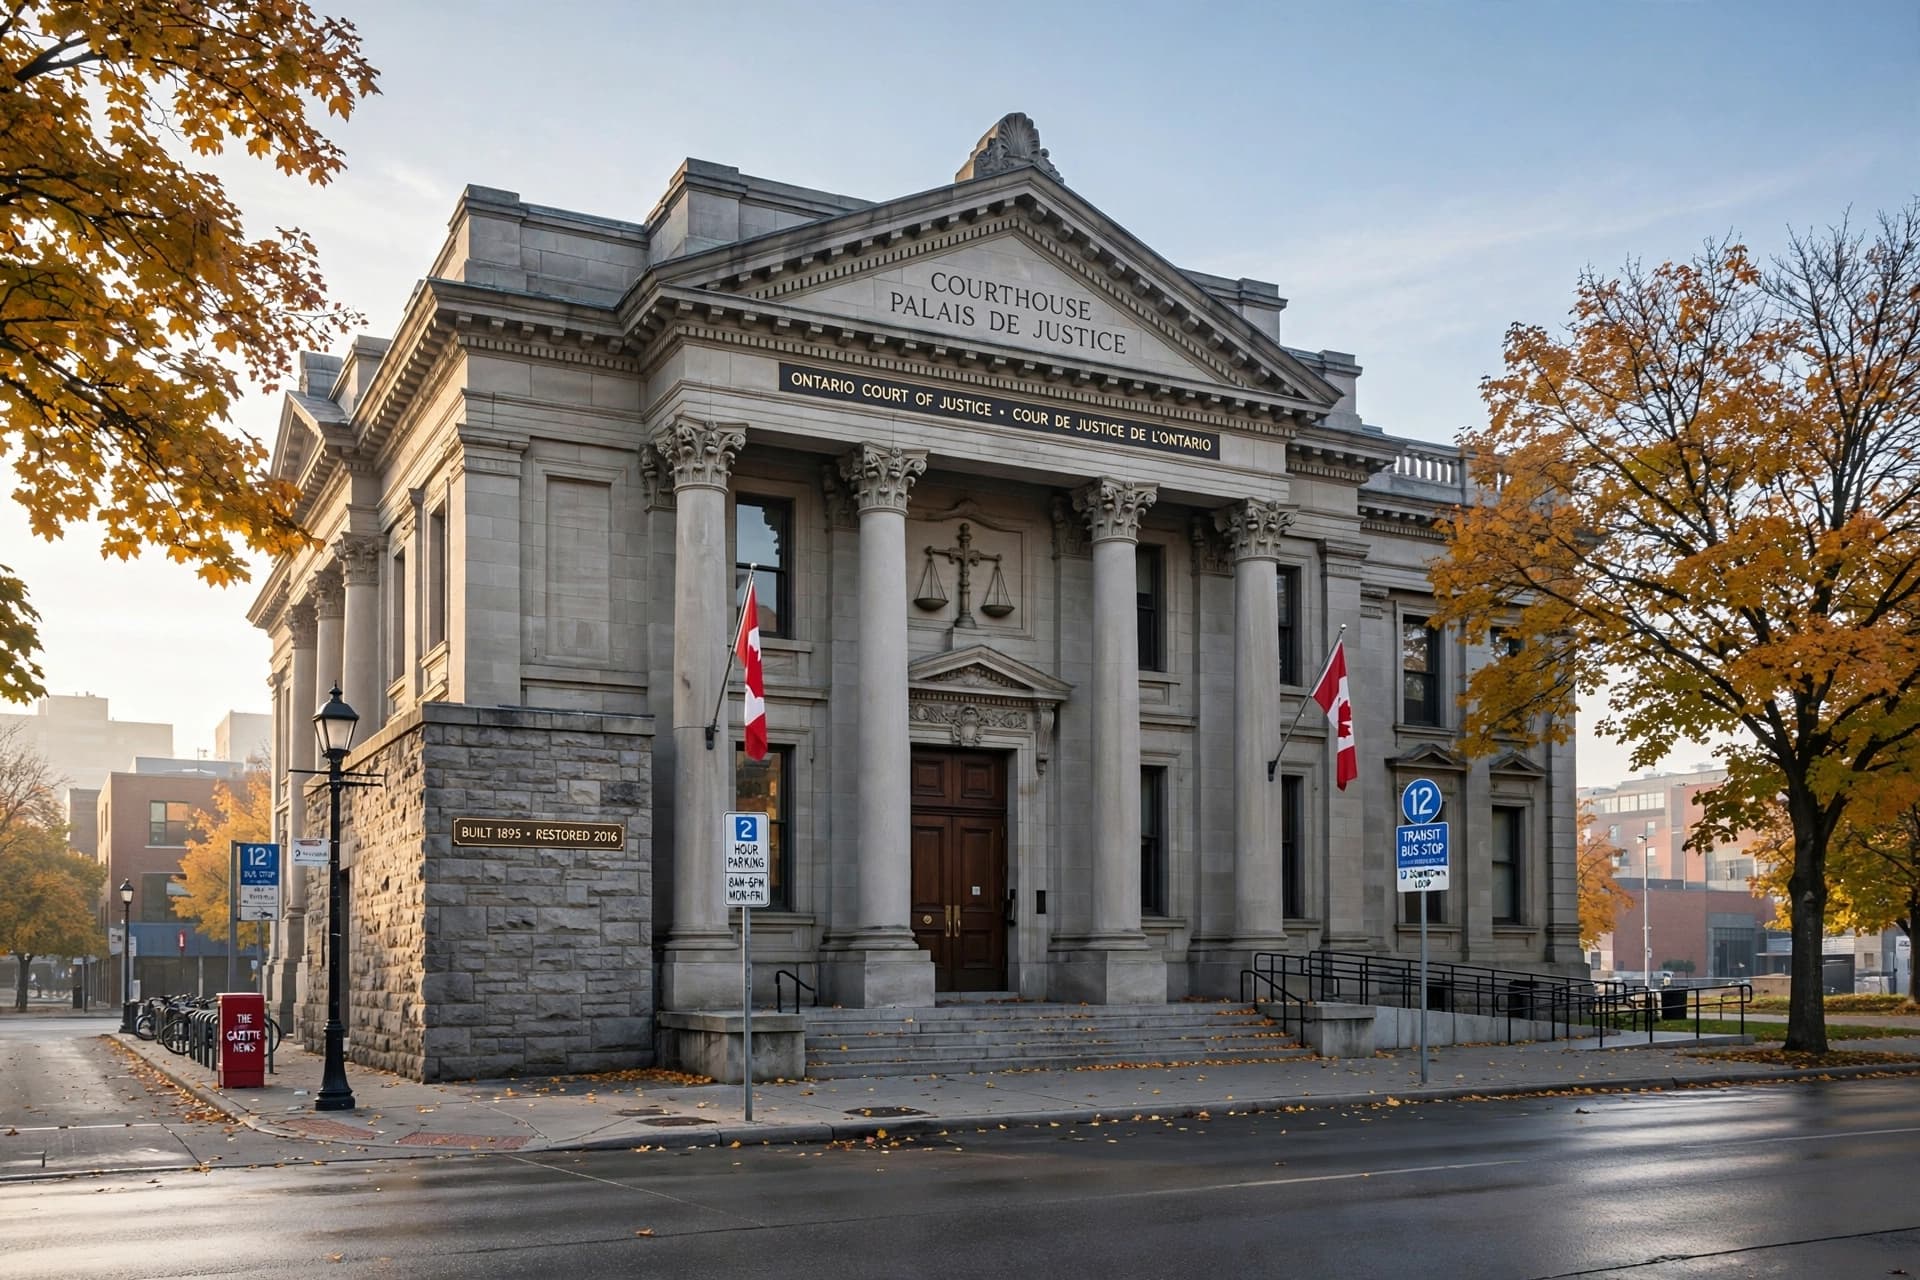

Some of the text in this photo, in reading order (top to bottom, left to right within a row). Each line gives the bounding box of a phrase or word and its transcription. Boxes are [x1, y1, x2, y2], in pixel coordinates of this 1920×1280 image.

[931, 272, 1092, 321] COURTHOUSE
[890, 291, 1127, 354] PALAIS DE JUSTICE
[791, 372, 1211, 451] ONTARIO COURT OF JUSTICE COUR DE JUSTICE DE L'ONTARIO
[1410, 786, 1433, 816] 12
[461, 826, 618, 842] BUILT 1895 RESTORED 2016
[740, 820, 753, 838] 2
[1402, 828, 1441, 843] TRANSIT
[247, 847, 267, 866] 12
[734, 844, 758, 855] HOUR
[1401, 843, 1444, 857] BUS STOP
[728, 857, 765, 868] PARKING
[729, 890, 764, 901] MON-FRI
[236, 1013, 253, 1024] THE
[232, 1042, 257, 1053] NEWS
